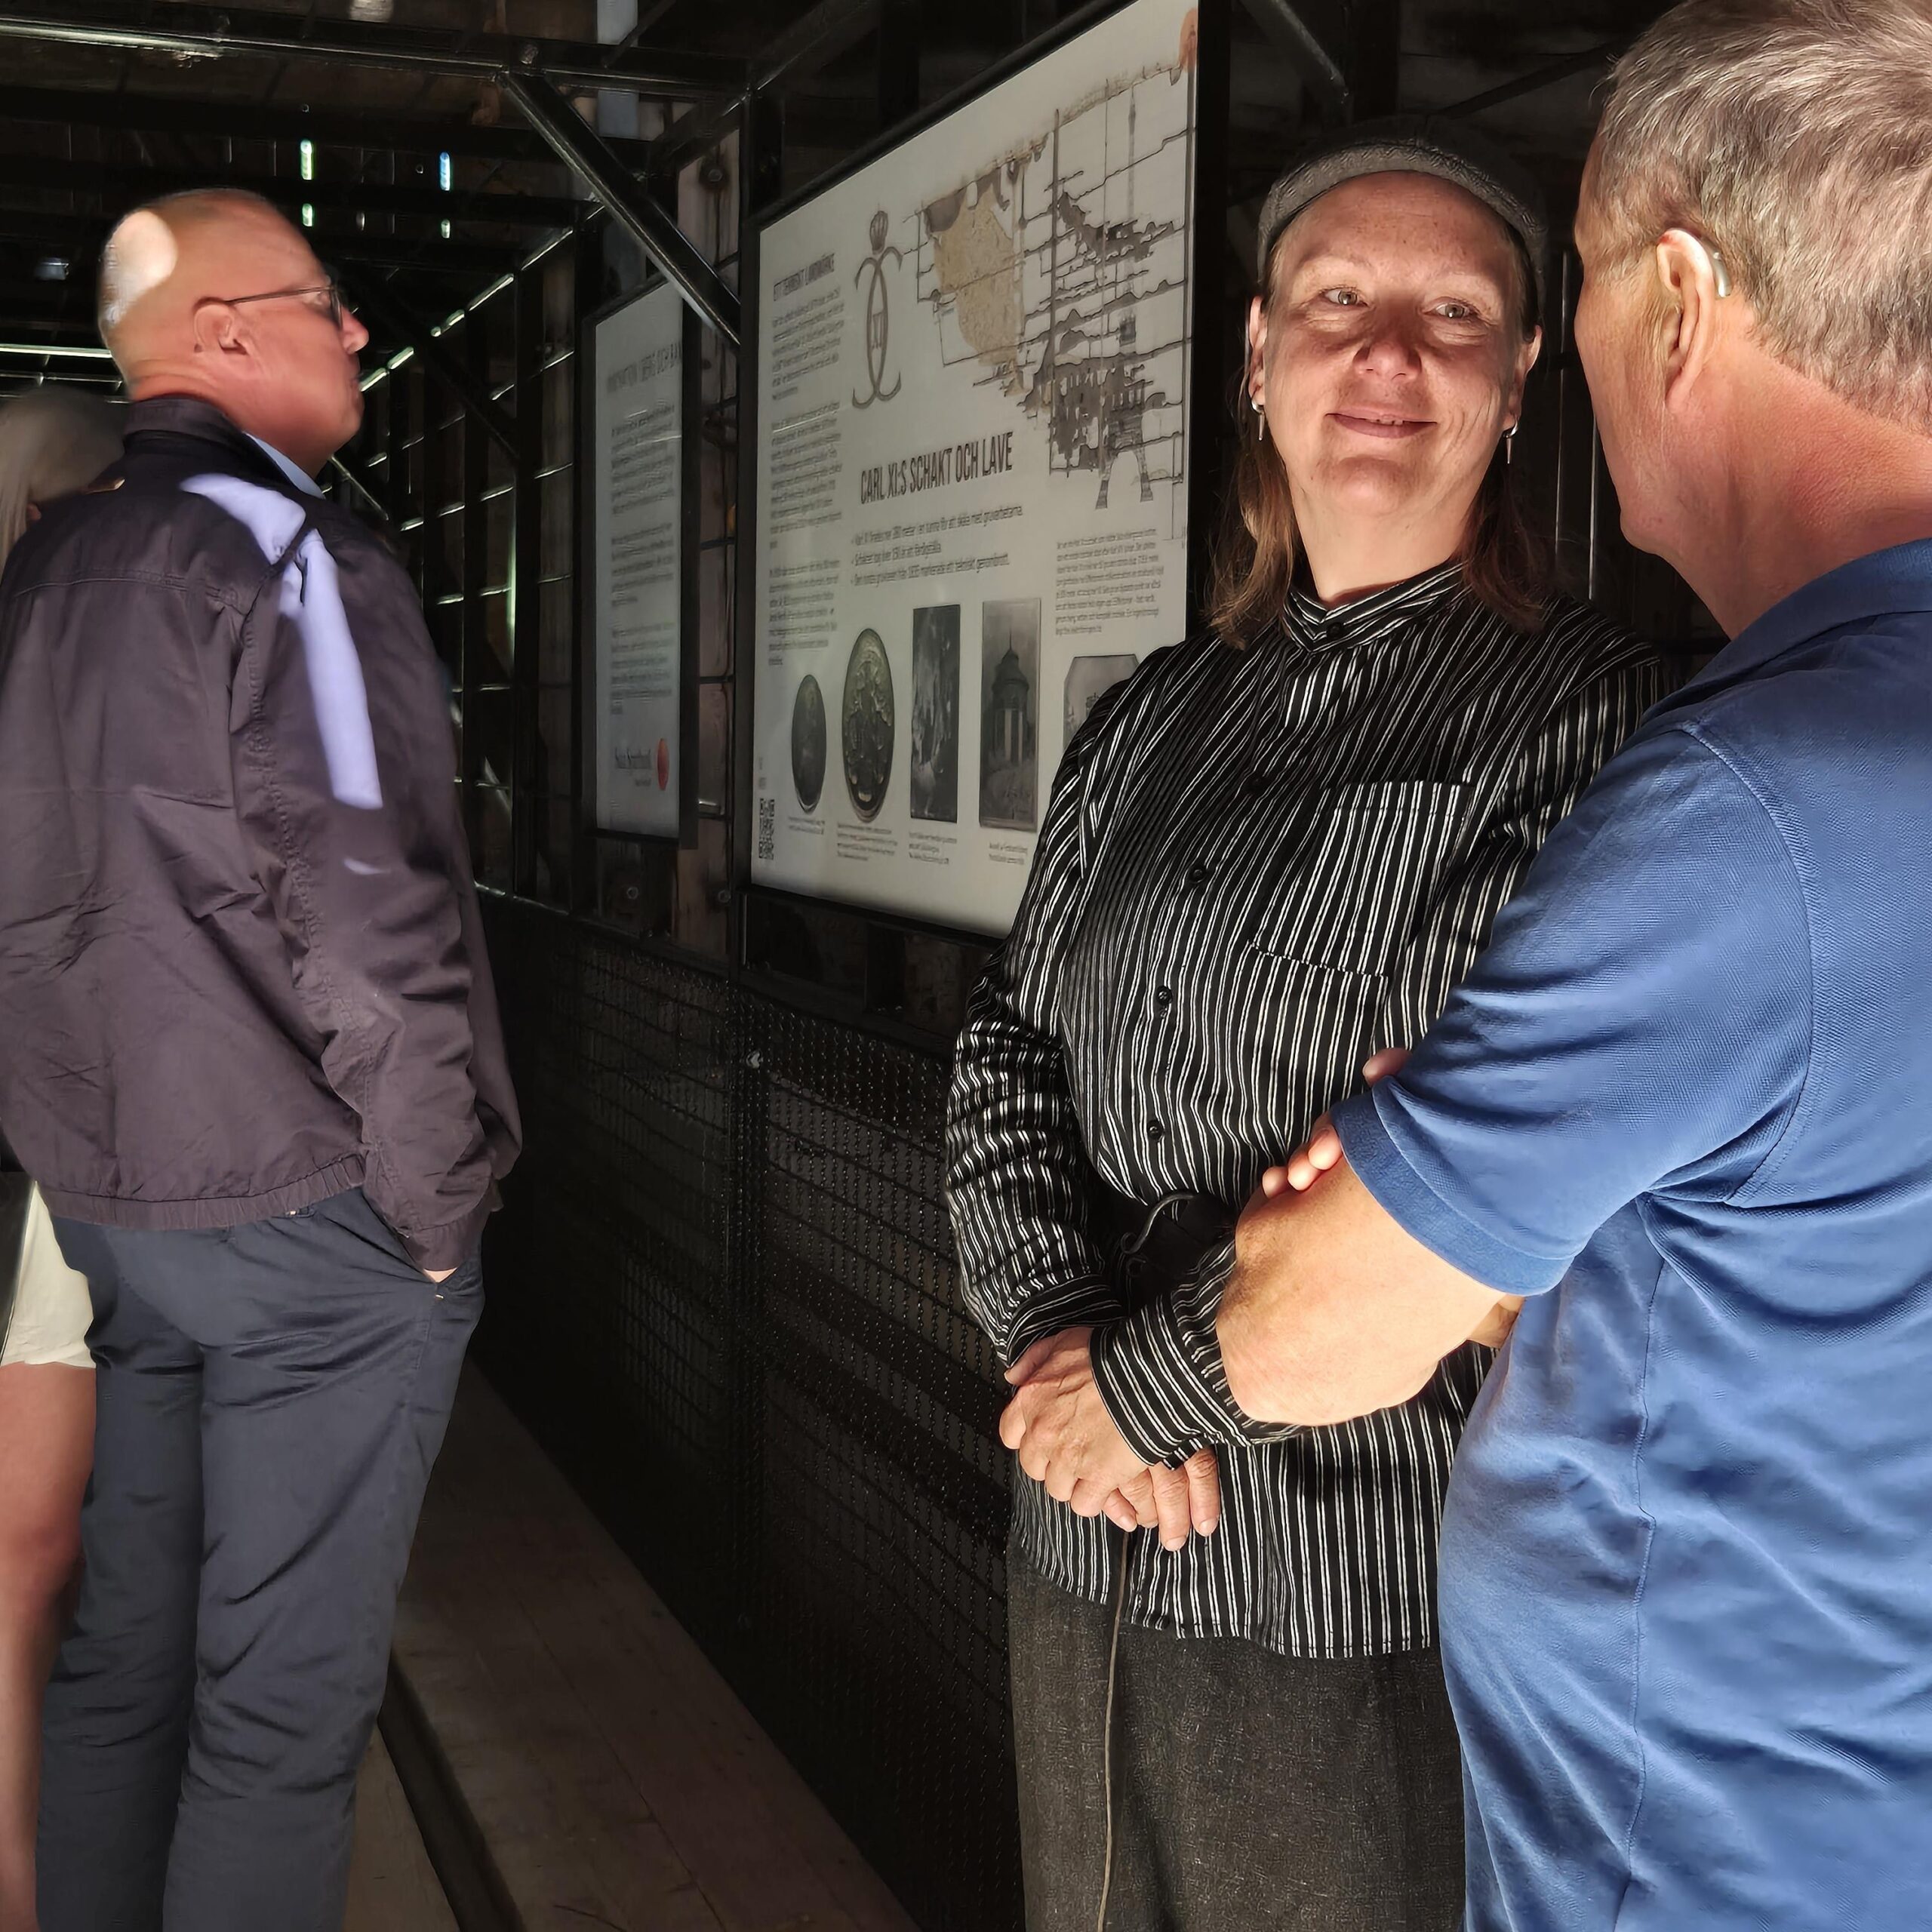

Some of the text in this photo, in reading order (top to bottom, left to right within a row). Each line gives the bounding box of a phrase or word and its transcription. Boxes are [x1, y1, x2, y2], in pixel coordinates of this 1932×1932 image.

[860, 466, 884, 504] CARL
[909, 448, 953, 493] SCHAKT
[955, 441, 979, 483] OCH
[982, 431, 1014, 477] LAVE
